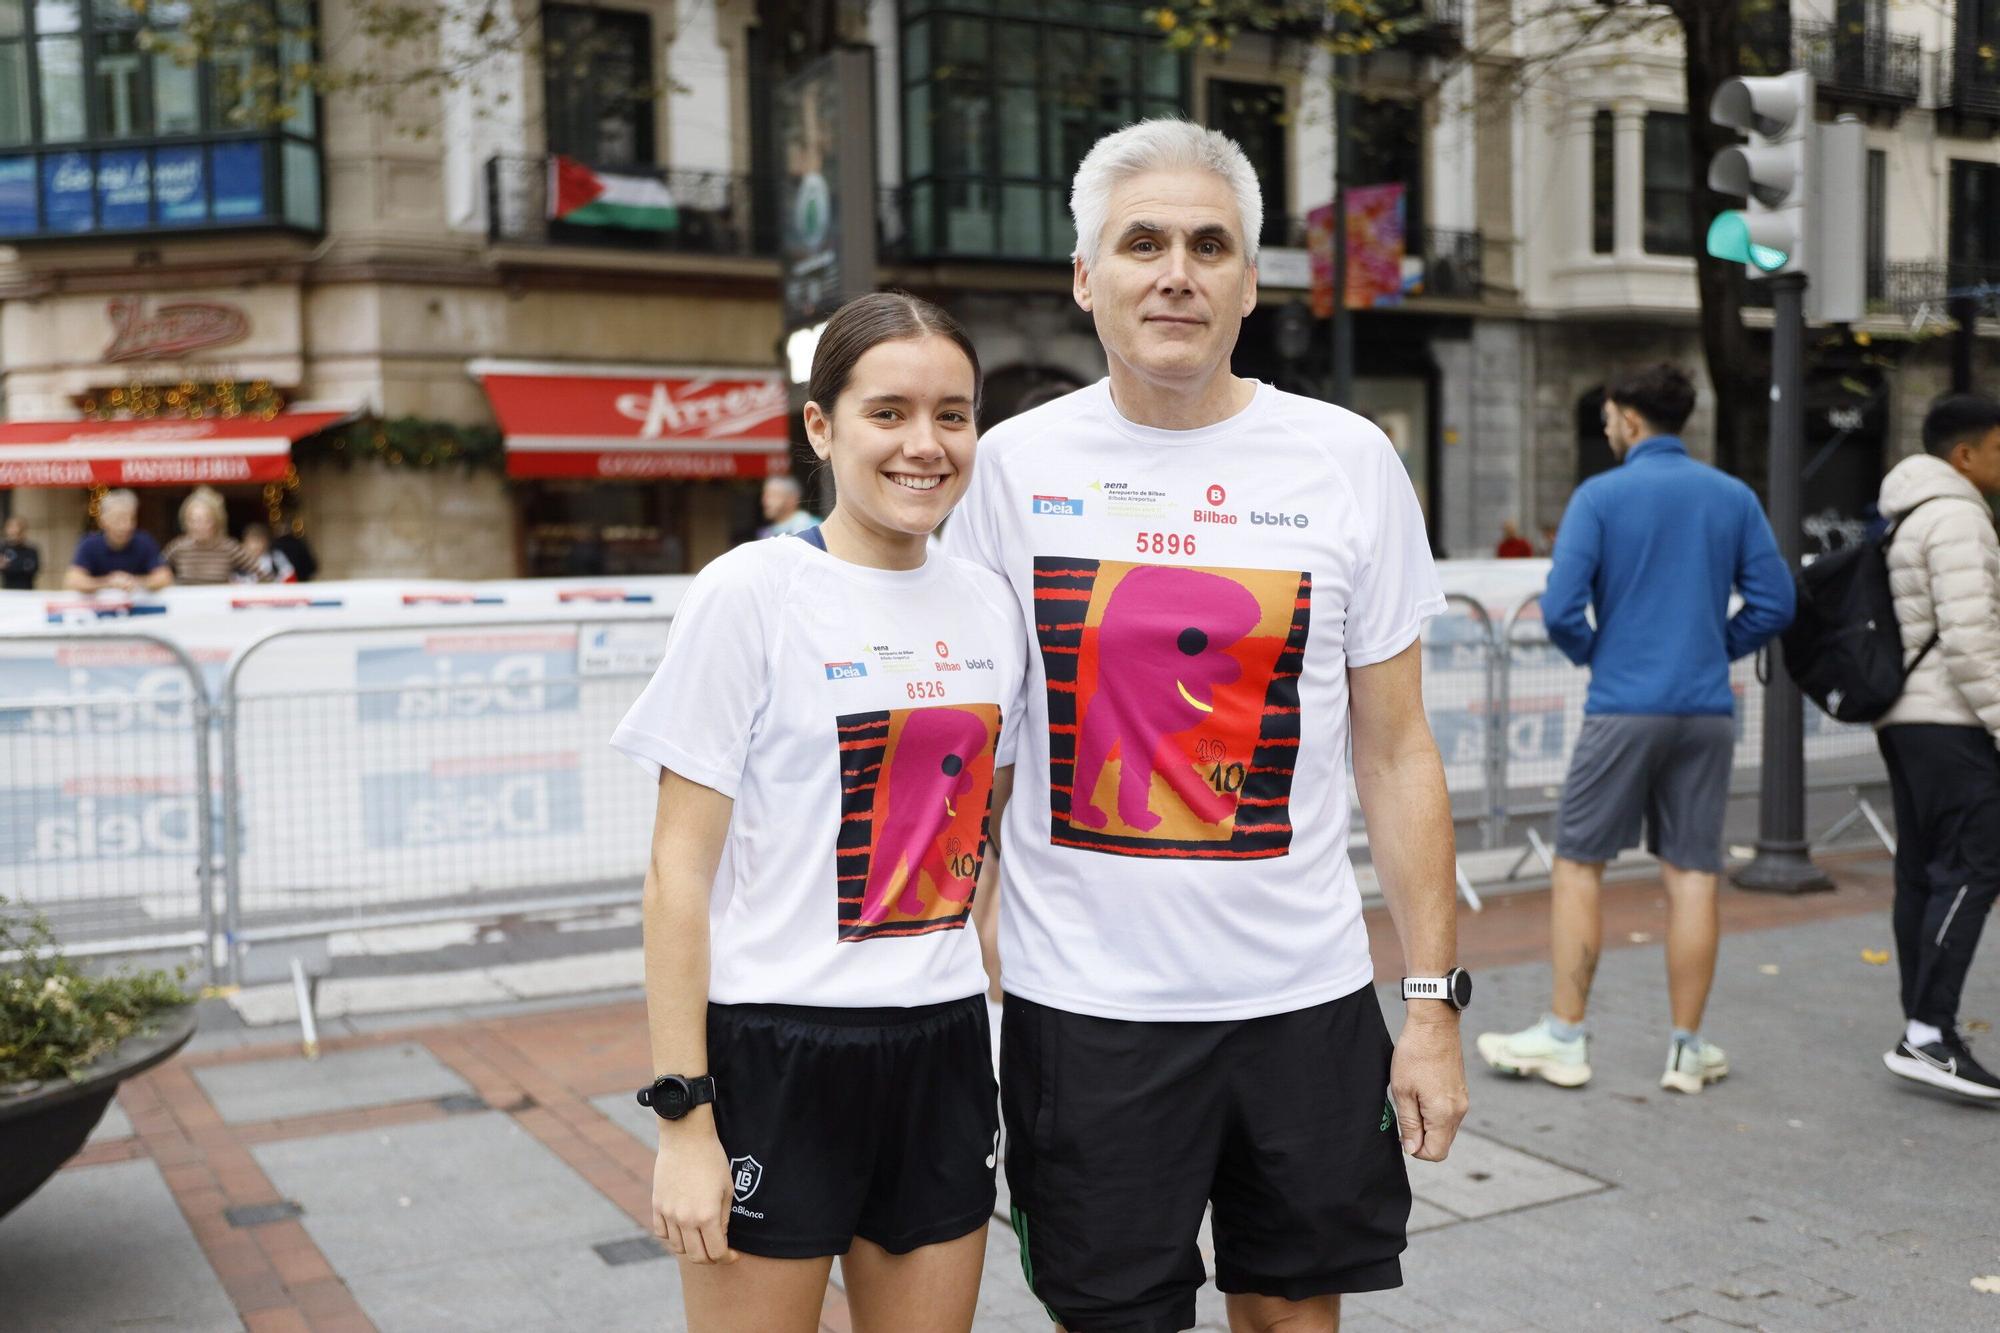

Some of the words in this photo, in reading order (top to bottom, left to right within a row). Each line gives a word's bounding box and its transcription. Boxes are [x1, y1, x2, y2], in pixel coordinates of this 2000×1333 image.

[1104, 481, 1128, 489] aena
[1108, 489, 1139, 498] Aeropuerto
[1040, 500, 1074, 515] Deia
[1193, 510, 1238, 525] Bilbao
[1250, 511, 1292, 527] bbk
[1136, 532, 1196, 556] 5896
[833, 666, 861, 679] Deia
[935, 662, 961, 672] Bilbao
[906, 681, 945, 699] 8526
[1196, 738, 1226, 762] 10
[1209, 761, 1245, 793] 10
[951, 853, 975, 877] 10
[732, 1204, 764, 1219] aBlanca
